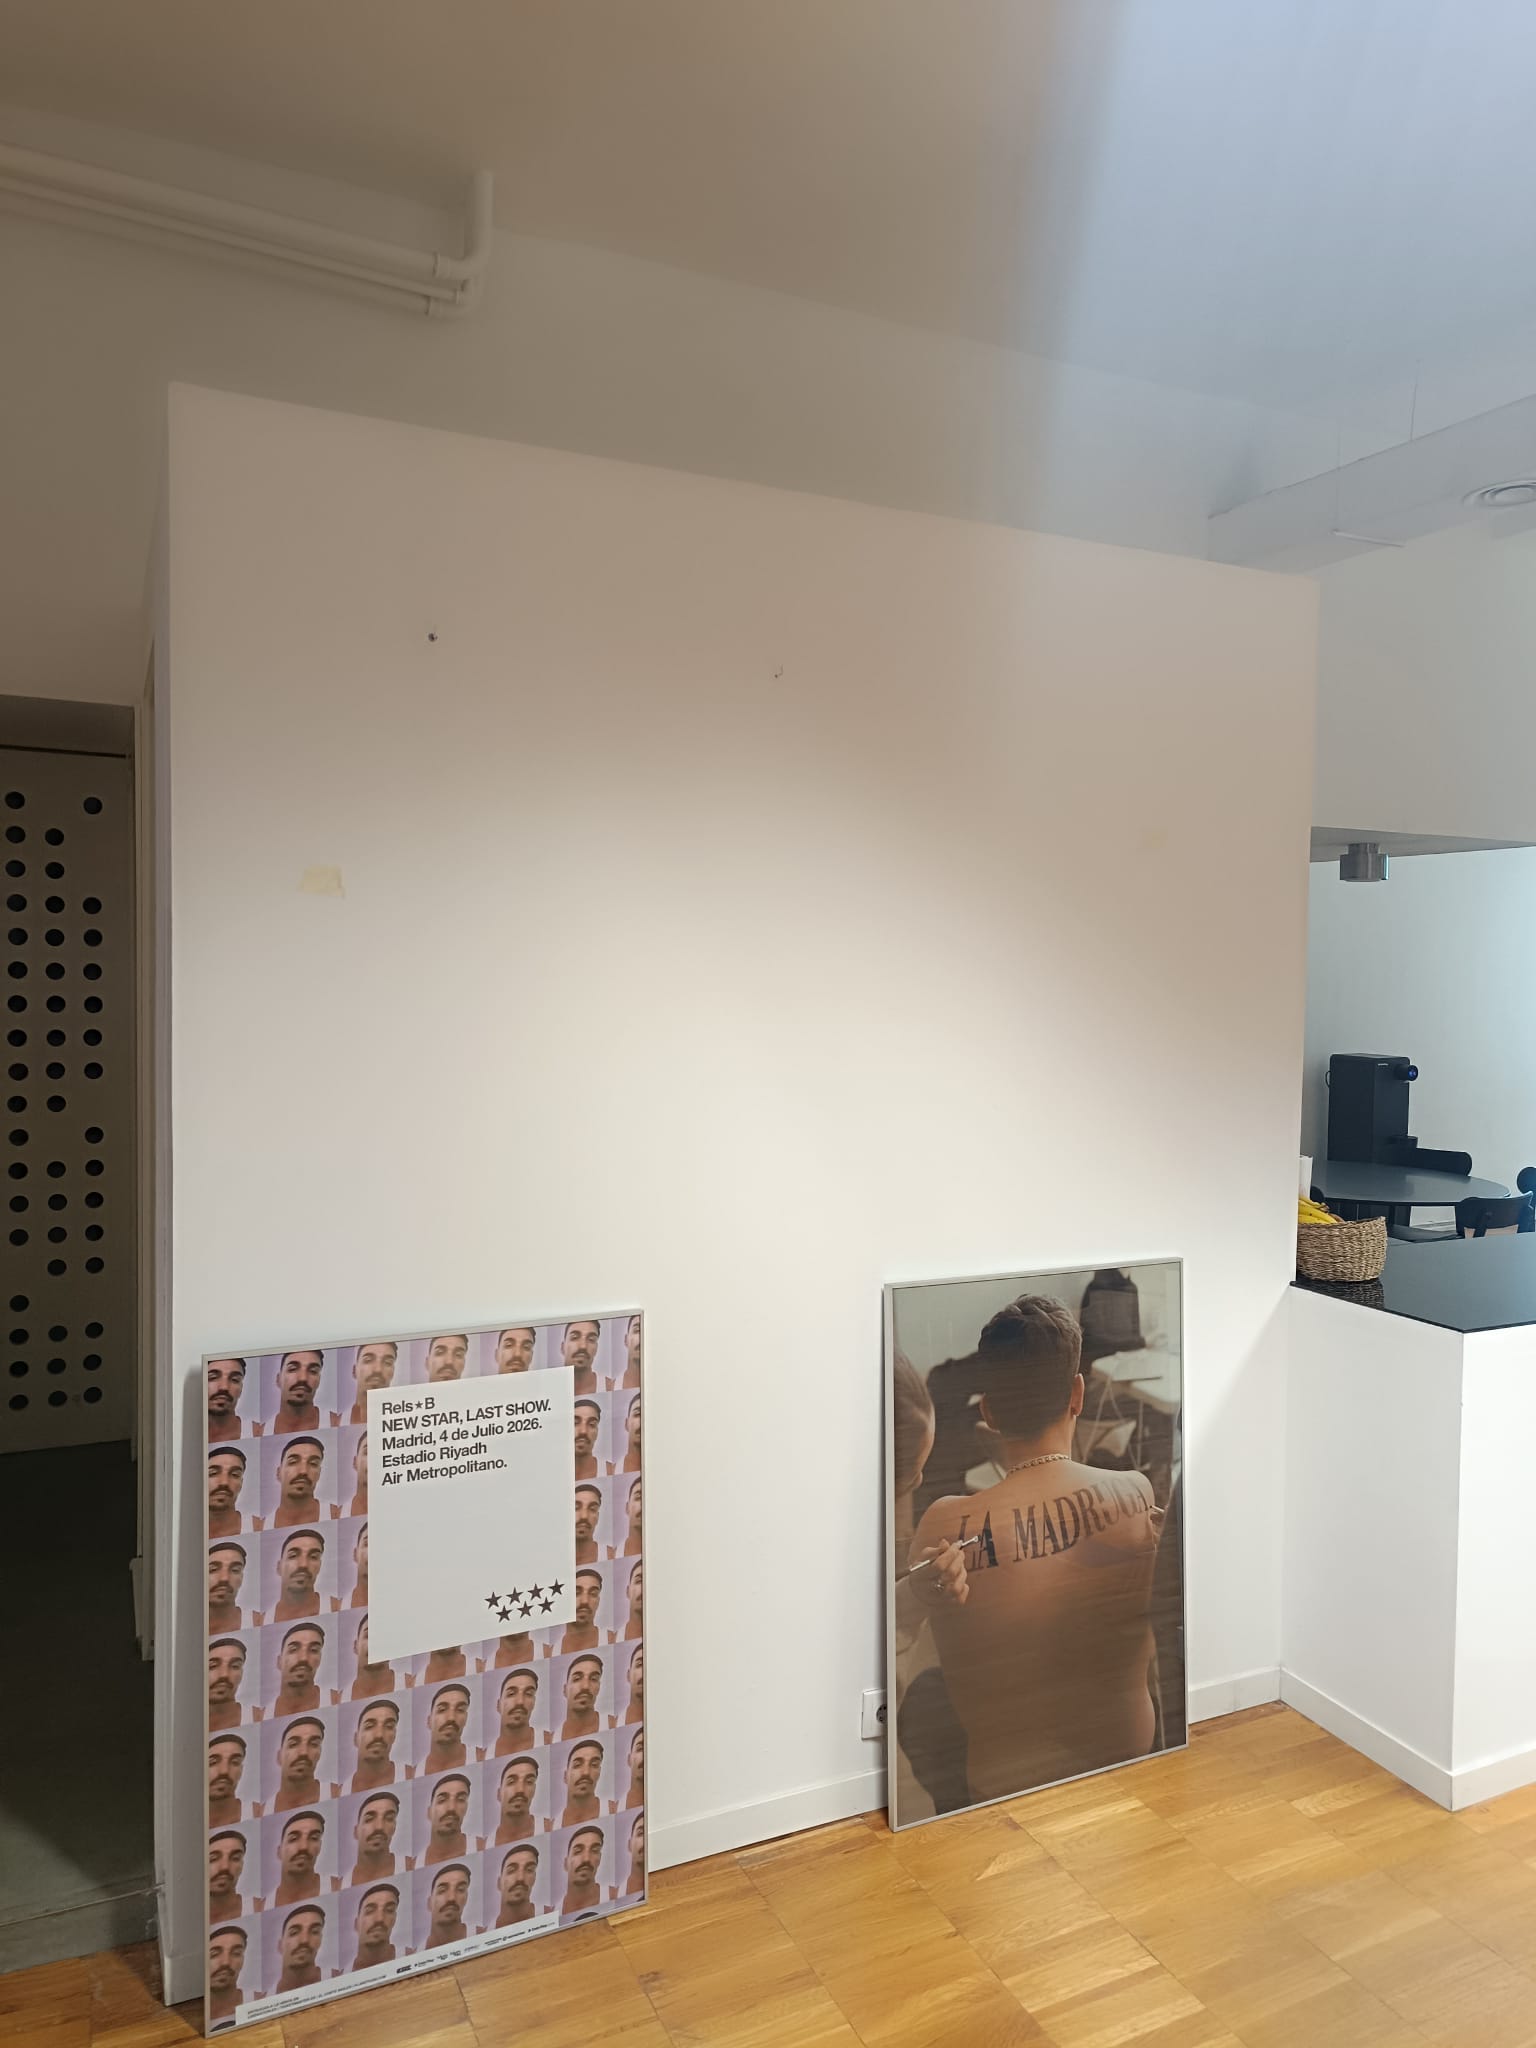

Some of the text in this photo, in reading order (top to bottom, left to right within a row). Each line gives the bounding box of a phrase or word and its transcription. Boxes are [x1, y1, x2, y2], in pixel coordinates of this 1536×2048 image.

[382, 1400, 413, 1414] Rels
[382, 1399, 551, 1433] NEW STAR, LAST SHOW.
[382, 1418, 542, 1450] Madrid, 4 de Julio 2026.
[382, 1442, 487, 1468] Estadio Riyadh
[382, 1458, 508, 1486] Air Metropolitano.
[957, 1510, 999, 1572] LA
